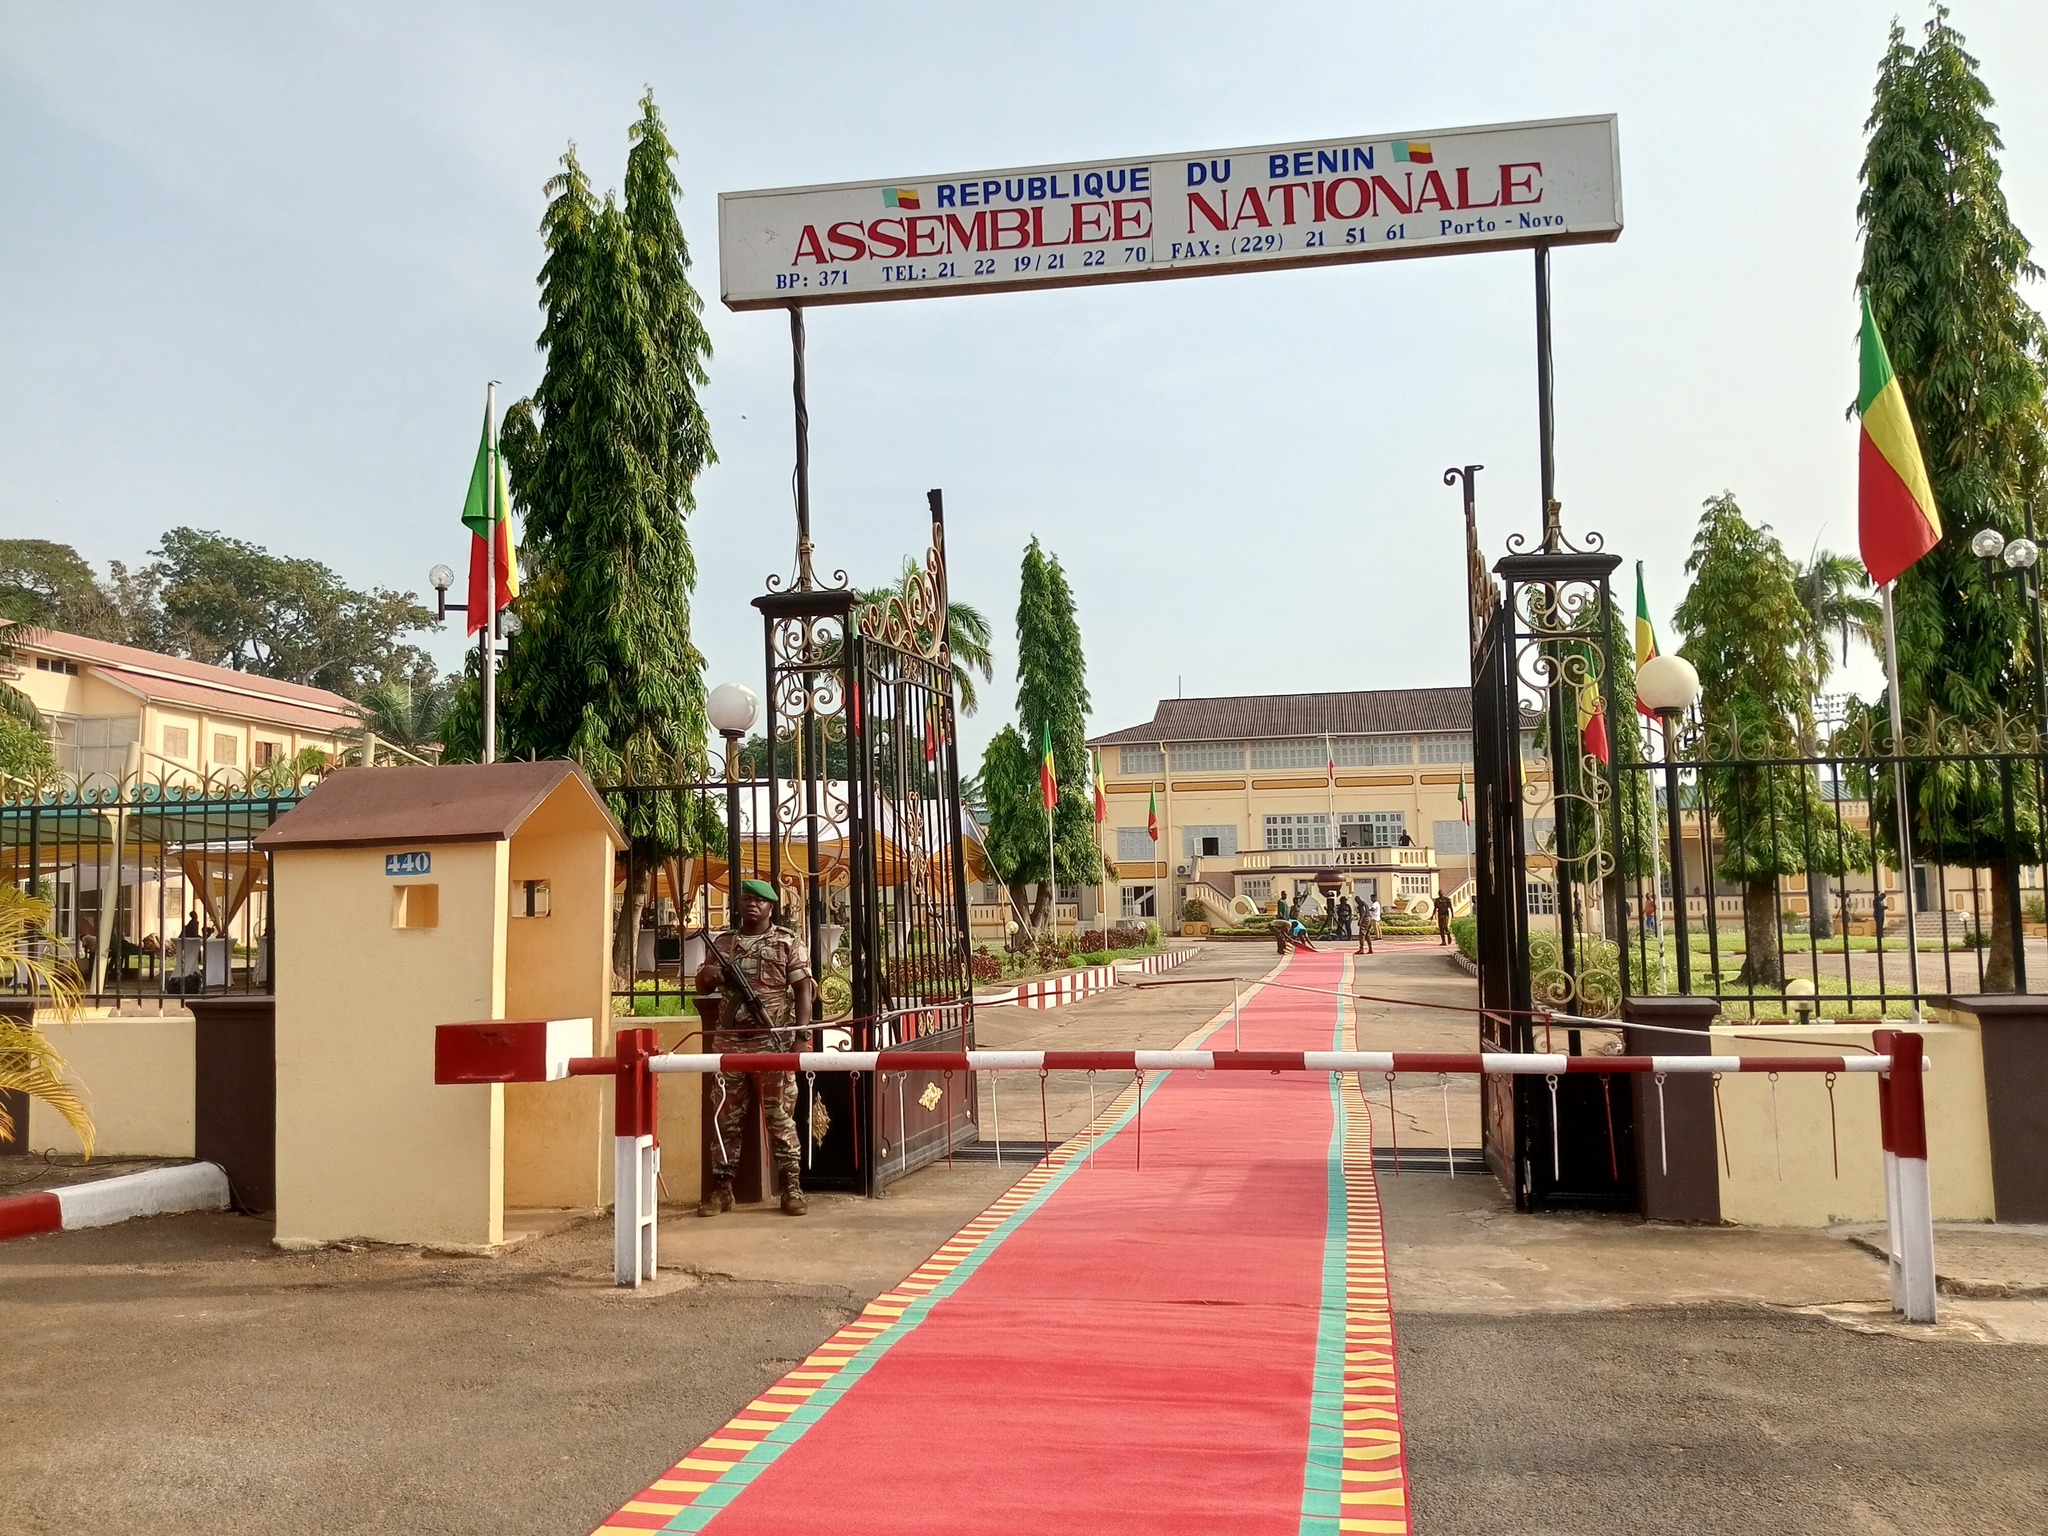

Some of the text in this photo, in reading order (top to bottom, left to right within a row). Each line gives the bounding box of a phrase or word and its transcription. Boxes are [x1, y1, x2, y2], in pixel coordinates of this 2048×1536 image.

[937, 144, 1375, 208] REPUBLIQUE DU BENIN
[791, 162, 1544, 266] ASSEMBLEE NATIONALE
[776, 274, 809, 290] BP:
[818, 269, 849, 287] 371
[882, 265, 928, 283] TEL:
[938, 262, 956, 279] 21
[974, 259, 997, 276] 22
[1083, 250, 1106, 267] 22
[1124, 247, 1147, 263] 70
[1171, 240, 1221, 260] FAX:
[1230, 232, 1285, 256] (229)
[1305, 230, 1325, 248] 21
[1345, 226, 1367, 244] 51
[1385, 223, 1406, 241] 61
[387, 853, 429, 872] 440
